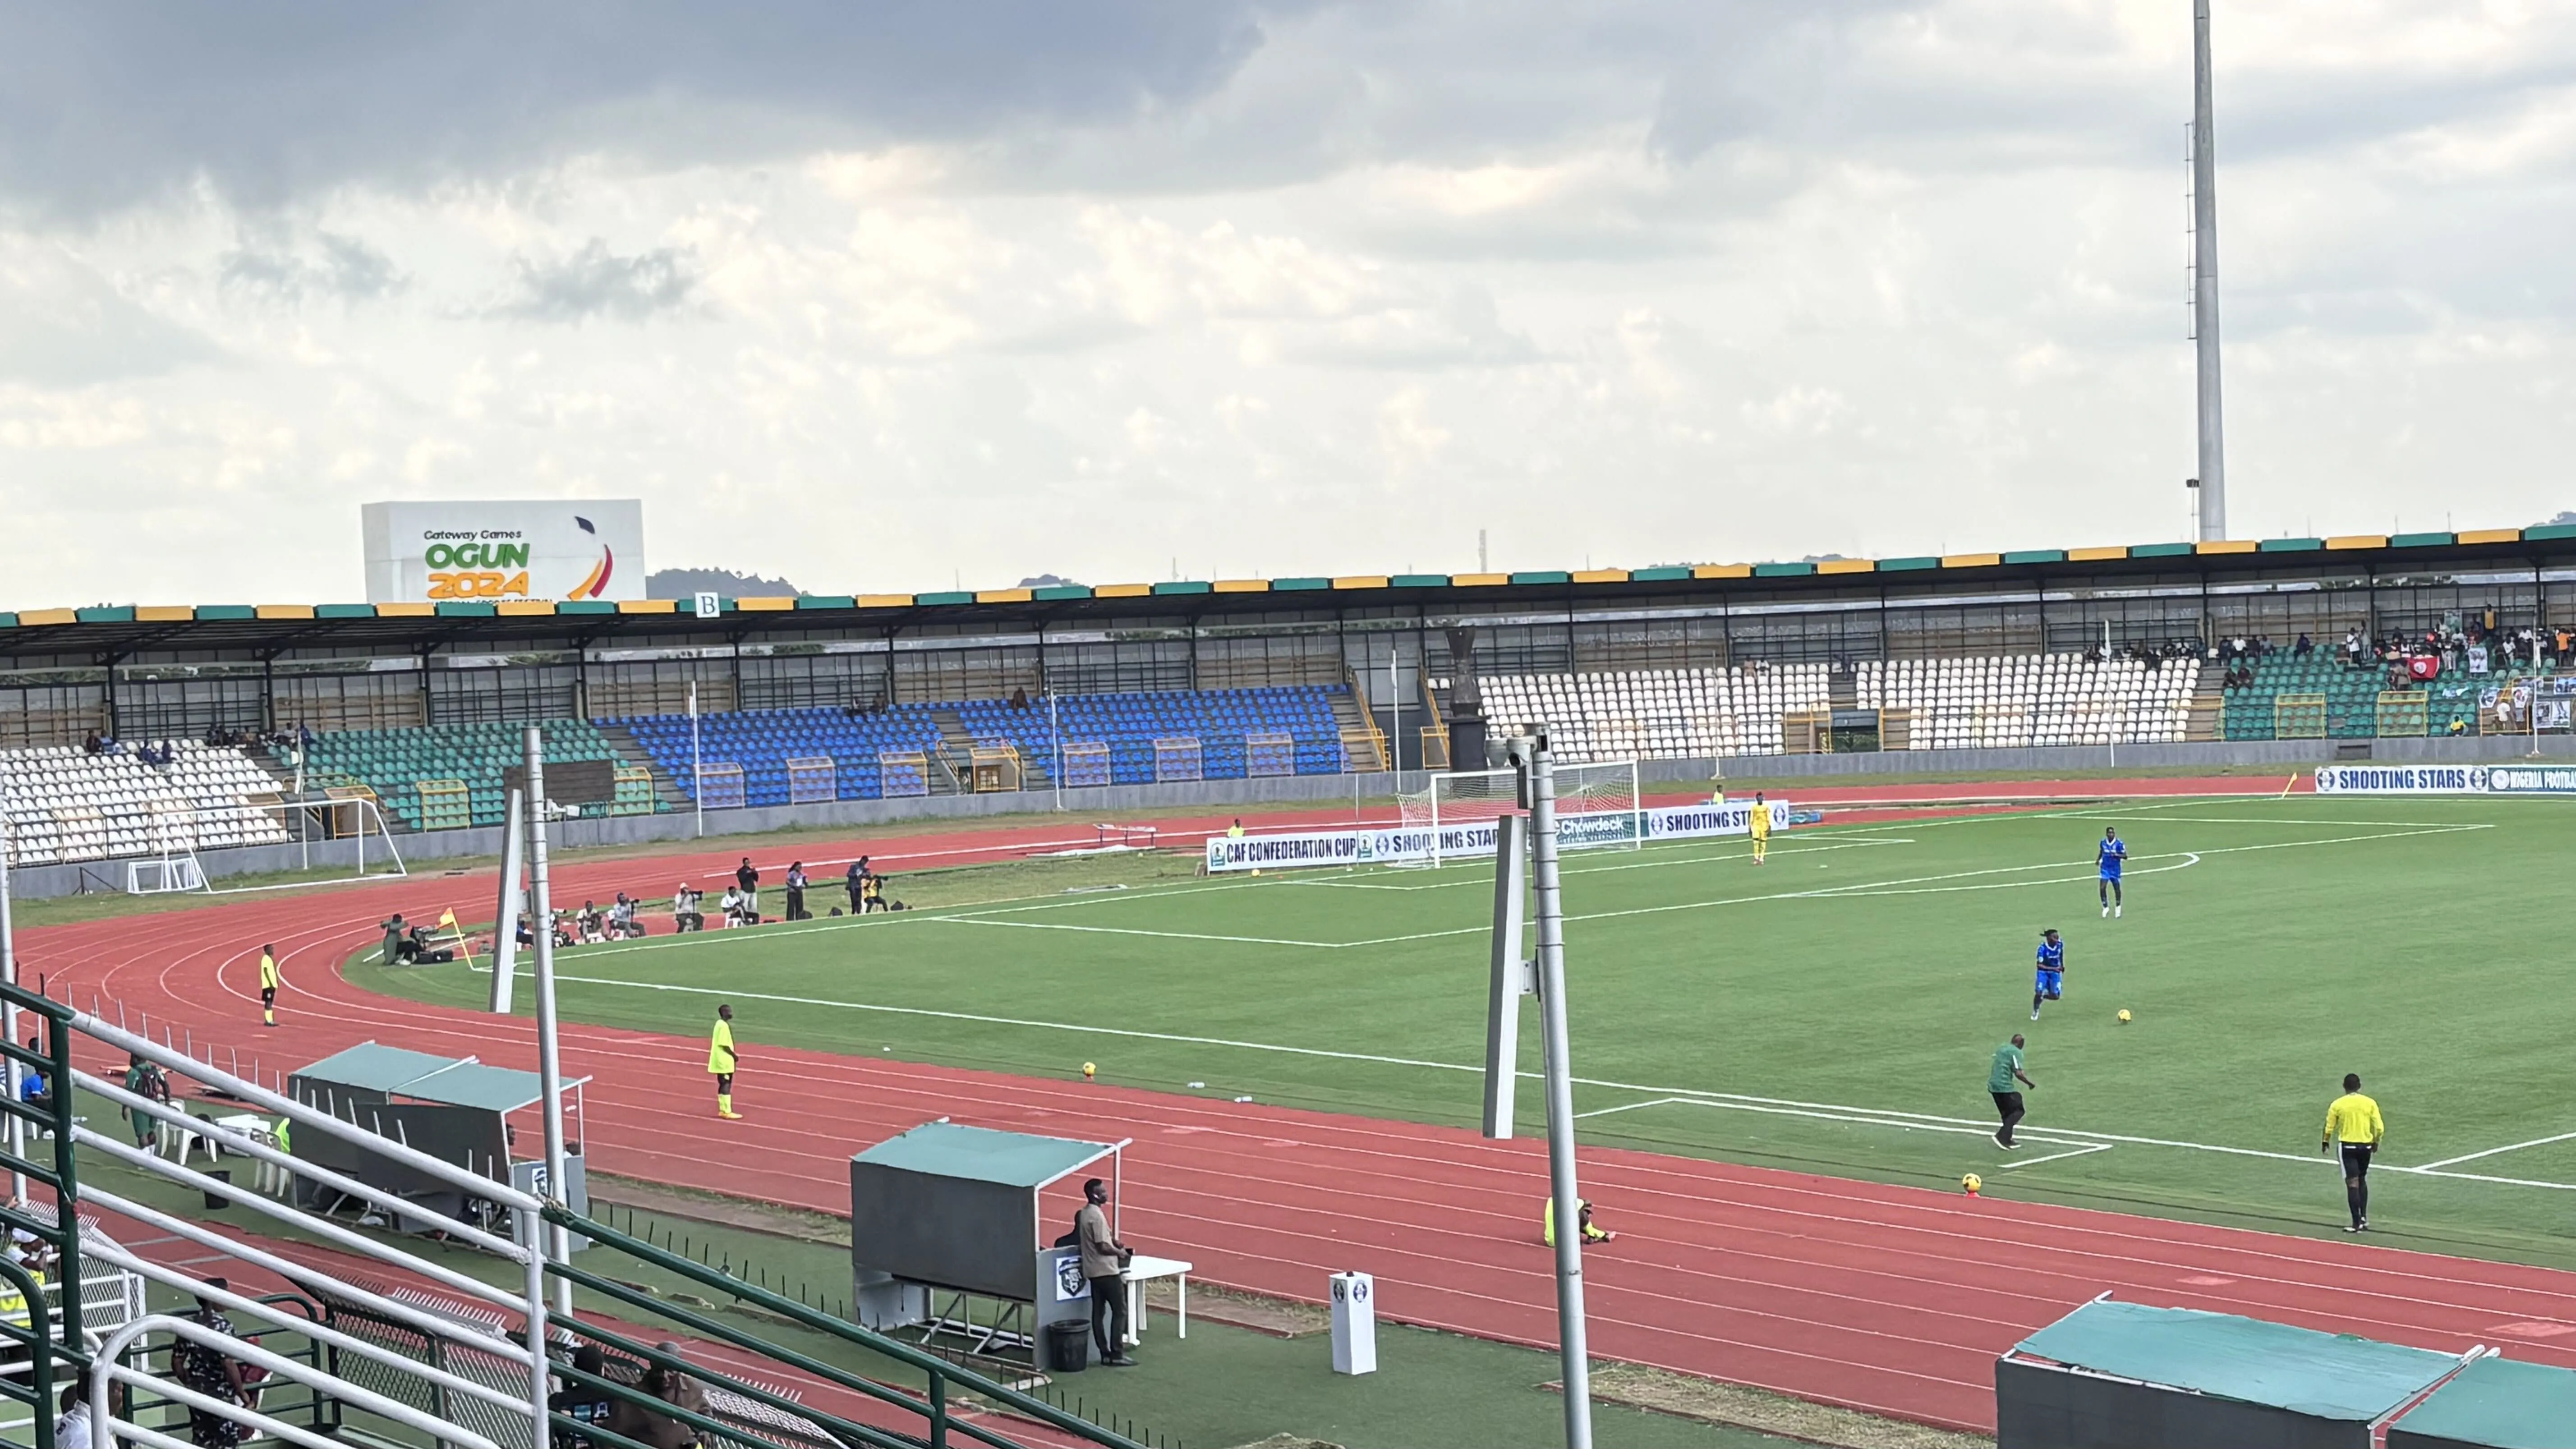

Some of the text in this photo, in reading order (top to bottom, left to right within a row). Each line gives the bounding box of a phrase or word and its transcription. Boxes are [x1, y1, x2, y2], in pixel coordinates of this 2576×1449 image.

[424, 530, 522, 541] Gateway Games
[425, 543, 530, 569] OGUN
[427, 571, 529, 598] 2024
[700, 596, 716, 614] B
[2339, 769, 2465, 789] SHOOTING STARS
[1561, 816, 1624, 834] Chowdeck
[1667, 812, 1729, 831] SHOOTING
[1227, 836, 1356, 863] CAF CONFEDERATION CUP
